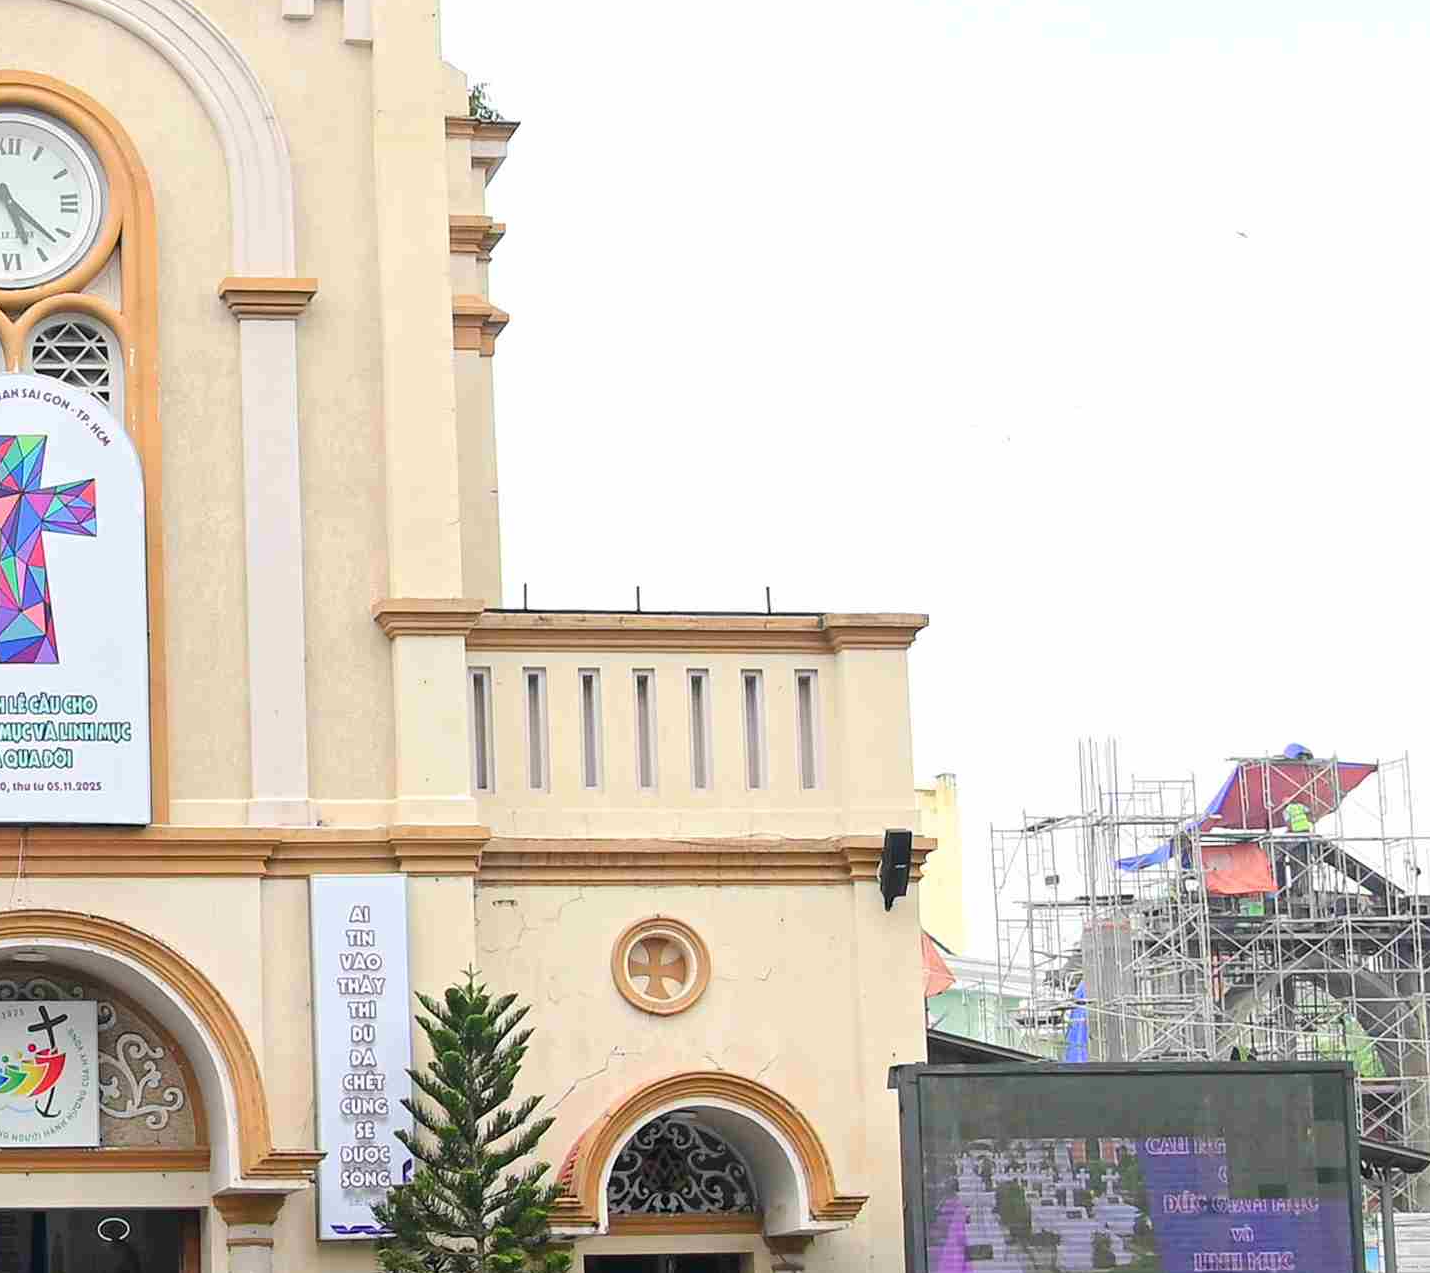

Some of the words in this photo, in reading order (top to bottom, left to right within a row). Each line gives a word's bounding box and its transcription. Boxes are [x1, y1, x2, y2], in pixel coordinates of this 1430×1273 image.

[62, 695, 98, 715] CHO
[59, 722, 96, 742] LINH
[3, 748, 41, 769] QUA
[349, 905, 371, 923] AI
[346, 929, 375, 947] TIN
